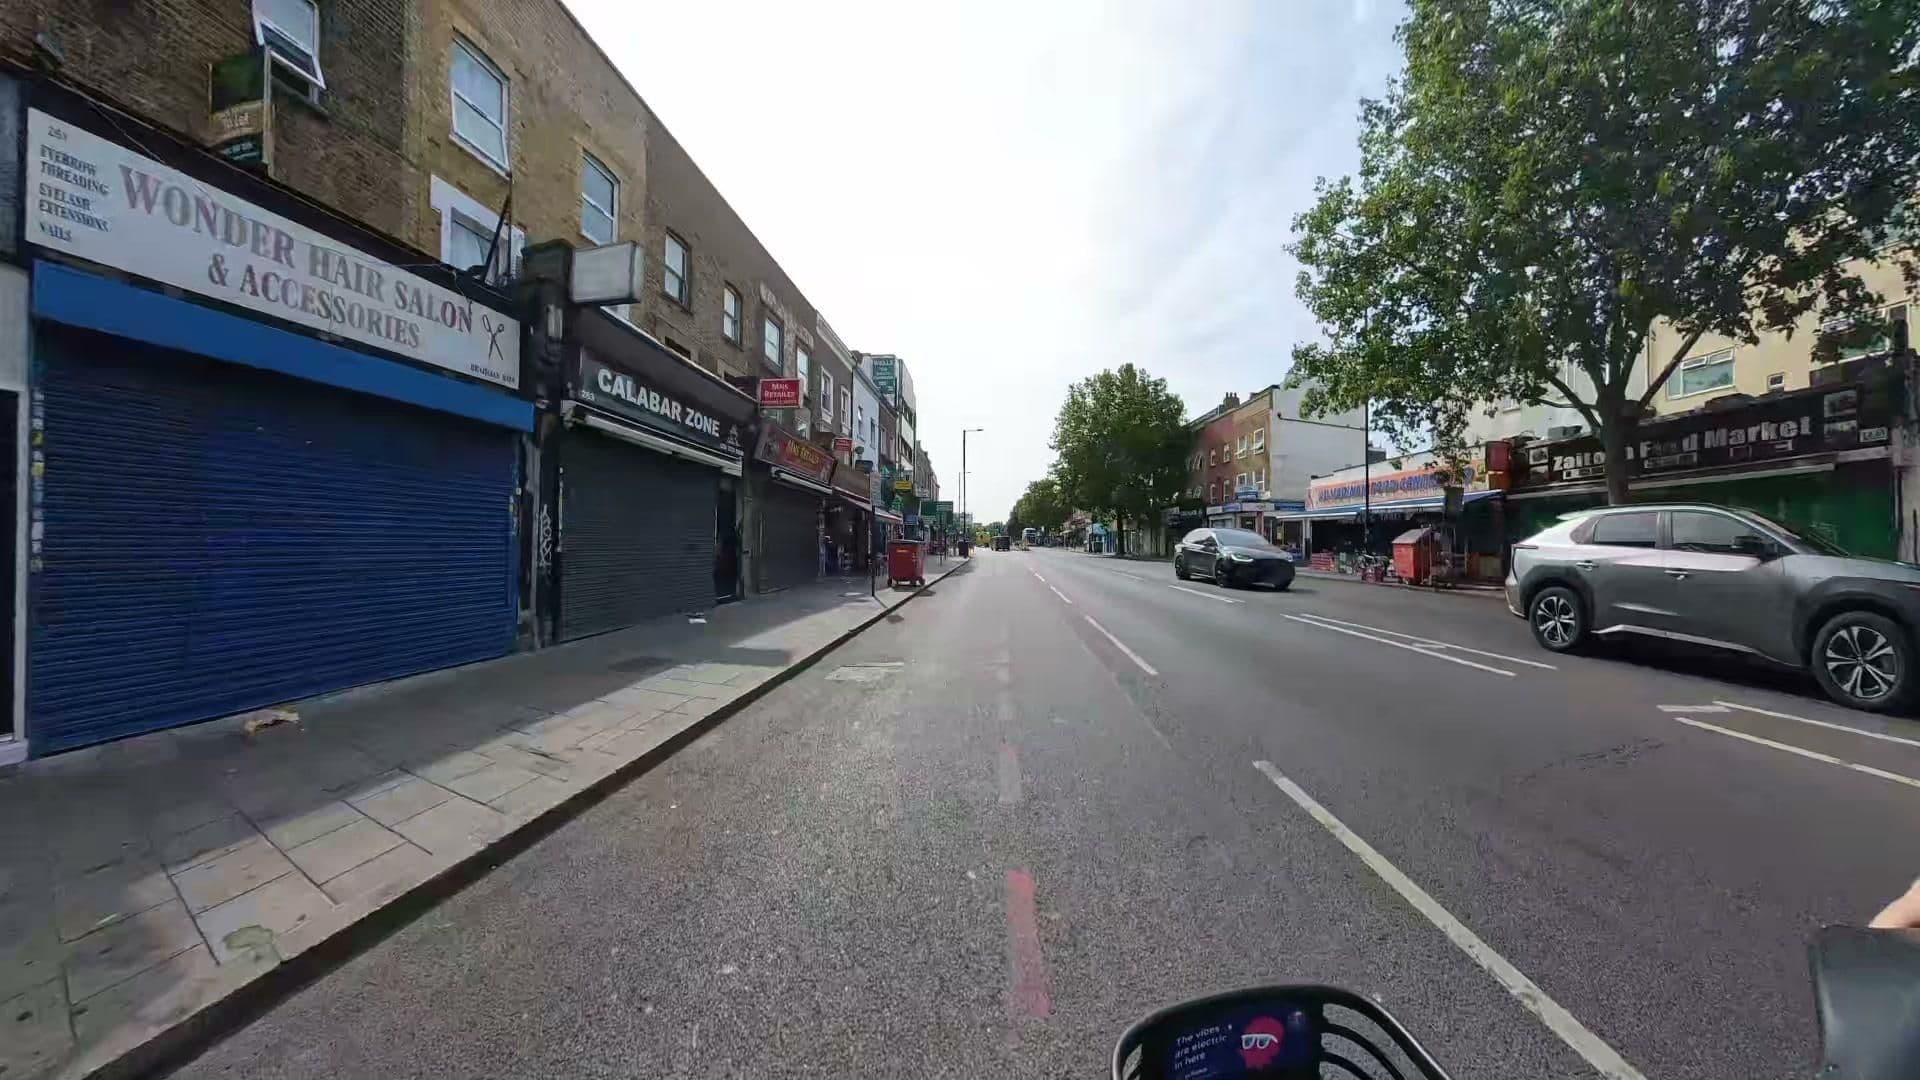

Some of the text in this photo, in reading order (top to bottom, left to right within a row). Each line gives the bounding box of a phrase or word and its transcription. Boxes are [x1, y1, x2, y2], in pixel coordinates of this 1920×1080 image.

[40, 161, 111, 195] THREADING
[40, 221, 72, 242] NAILS
[119, 164, 295, 269] WONDER
[208, 253, 421, 349] & ACCESSORIES
[308, 244, 473, 335] HAIR SALON
[597, 368, 721, 437] CALABAR ZONE
[1704, 416, 1812, 449] Market
[1176, 1033, 1194, 1046] The
[1185, 1051, 1206, 1066] here
